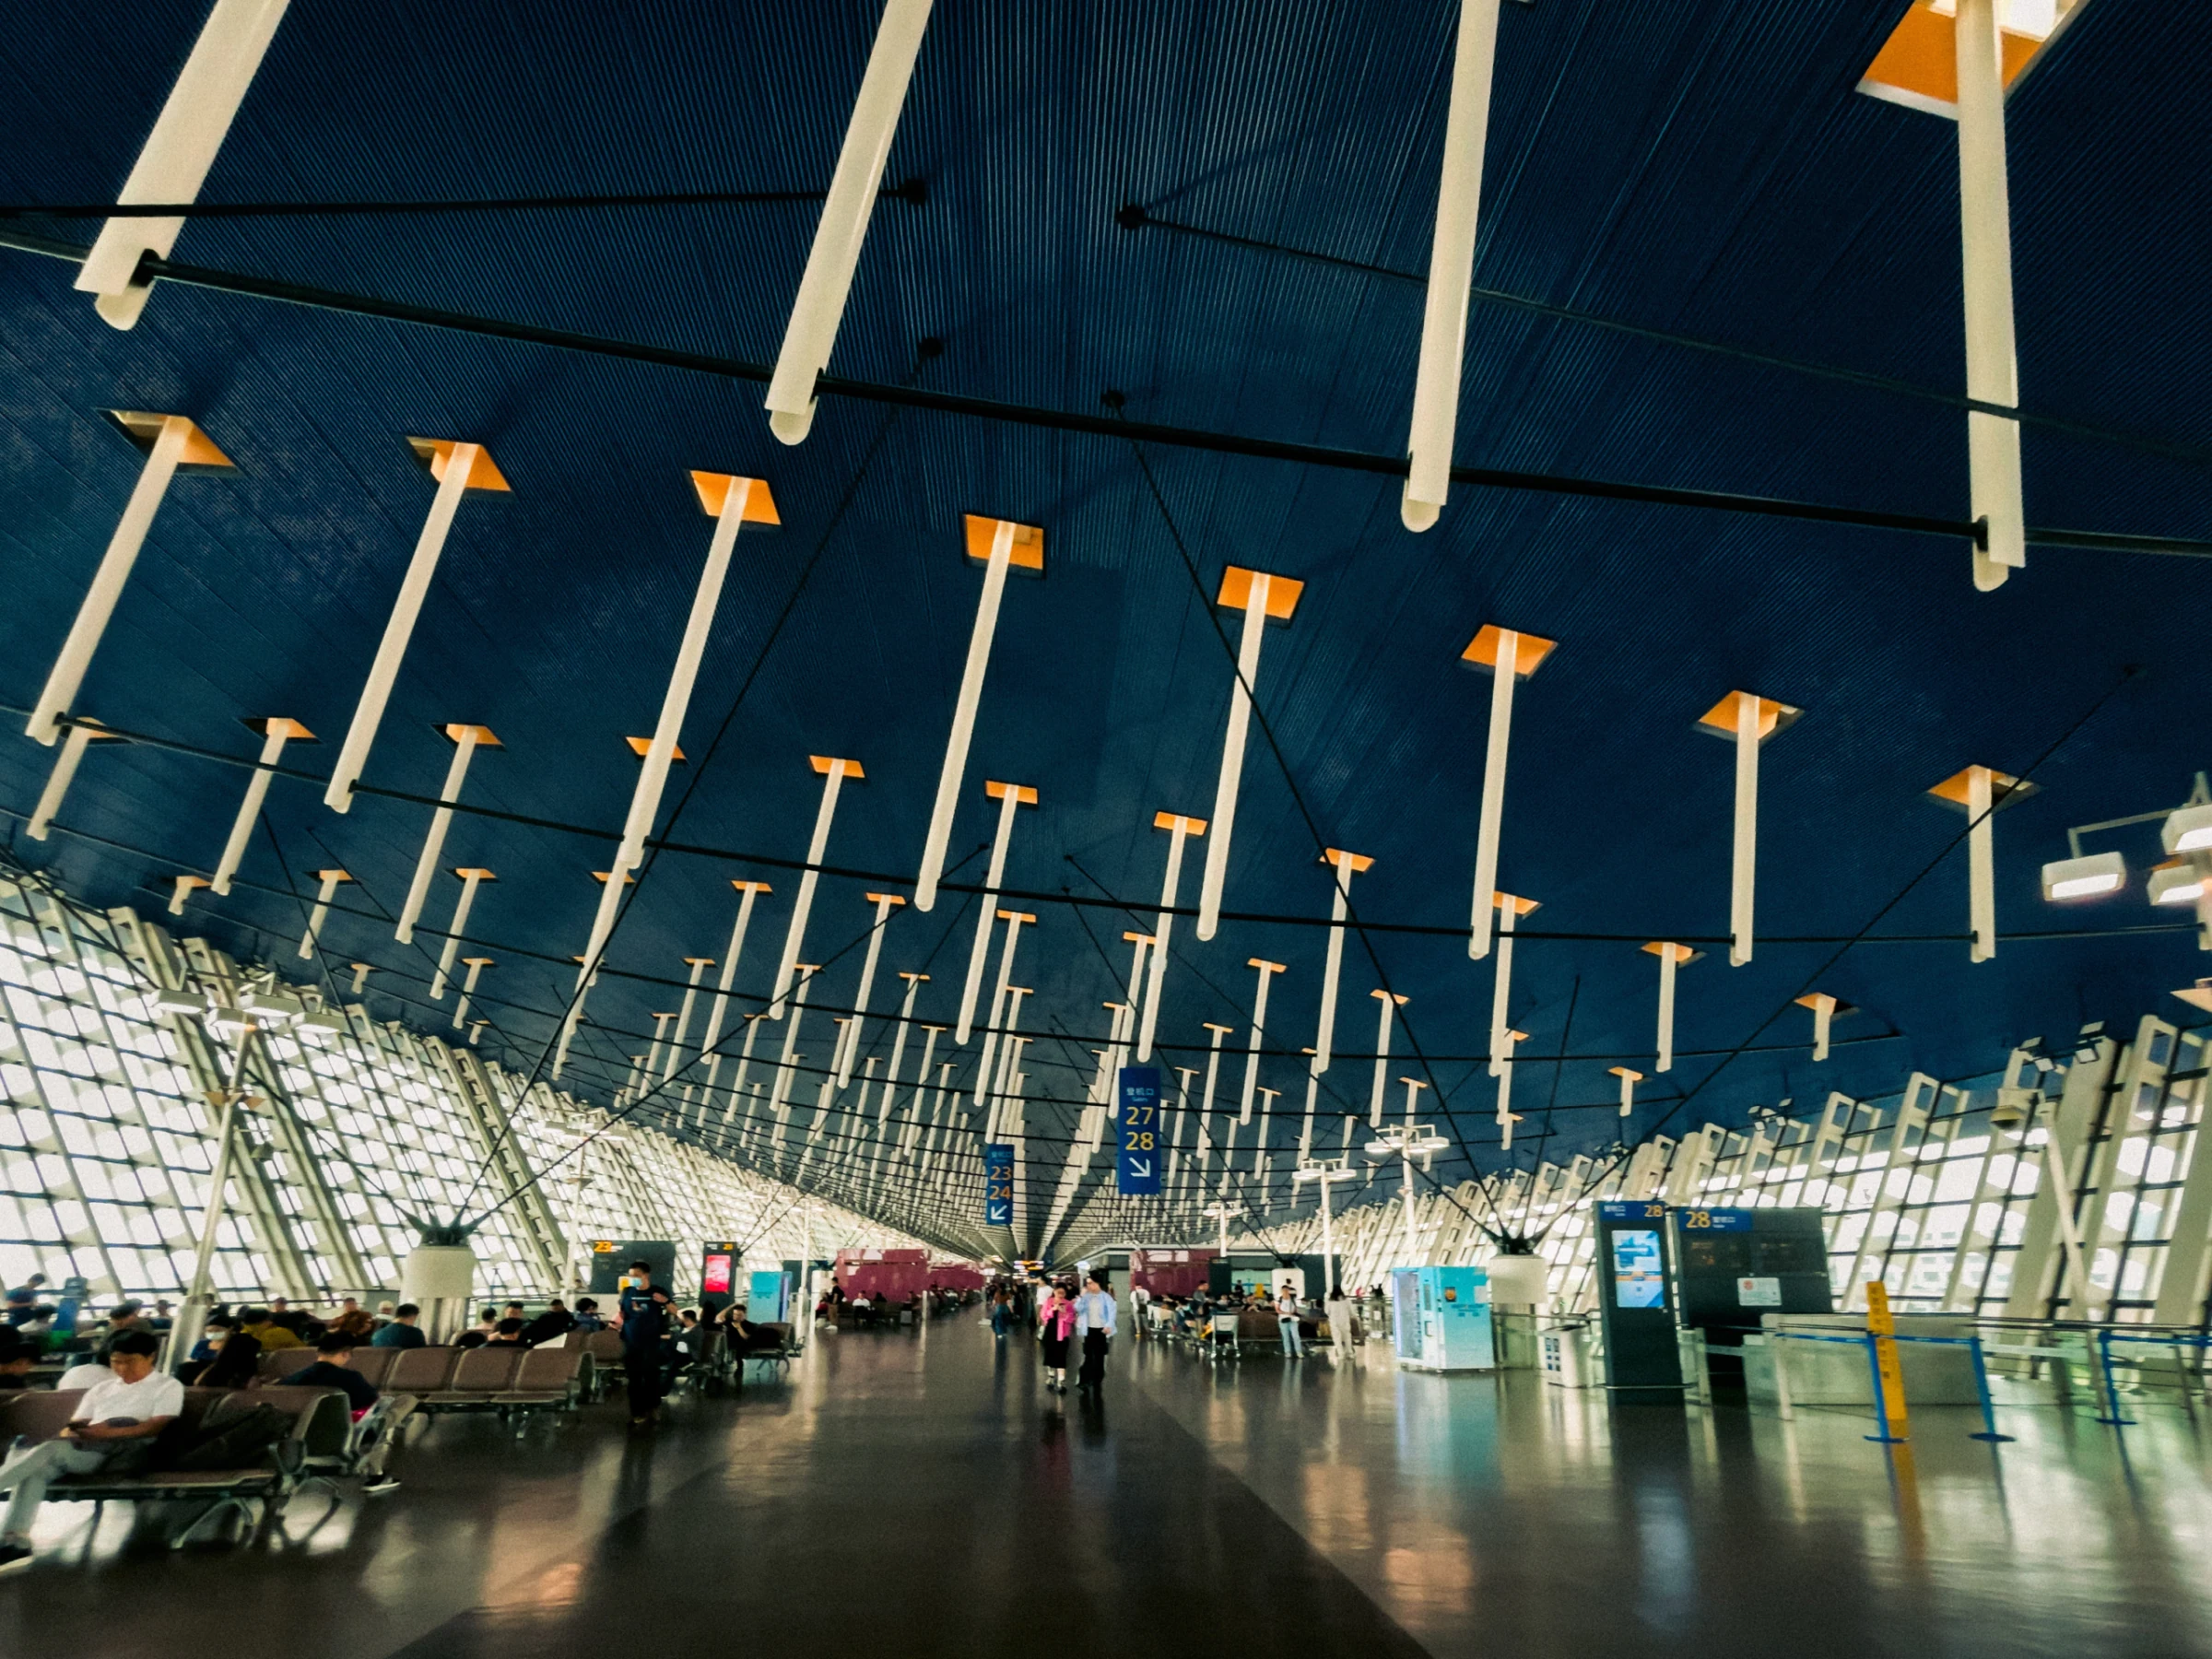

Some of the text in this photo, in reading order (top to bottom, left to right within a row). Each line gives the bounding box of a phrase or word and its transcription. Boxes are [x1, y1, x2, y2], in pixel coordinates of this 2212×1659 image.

[1125, 1106, 1154, 1125] 27
[1125, 1131, 1154, 1151] 28
[990, 1166, 1012, 1180] 23
[989, 1185, 1011, 1200] 24
[1644, 1205, 1664, 1218] 28
[1685, 1210, 1711, 1229] 28
